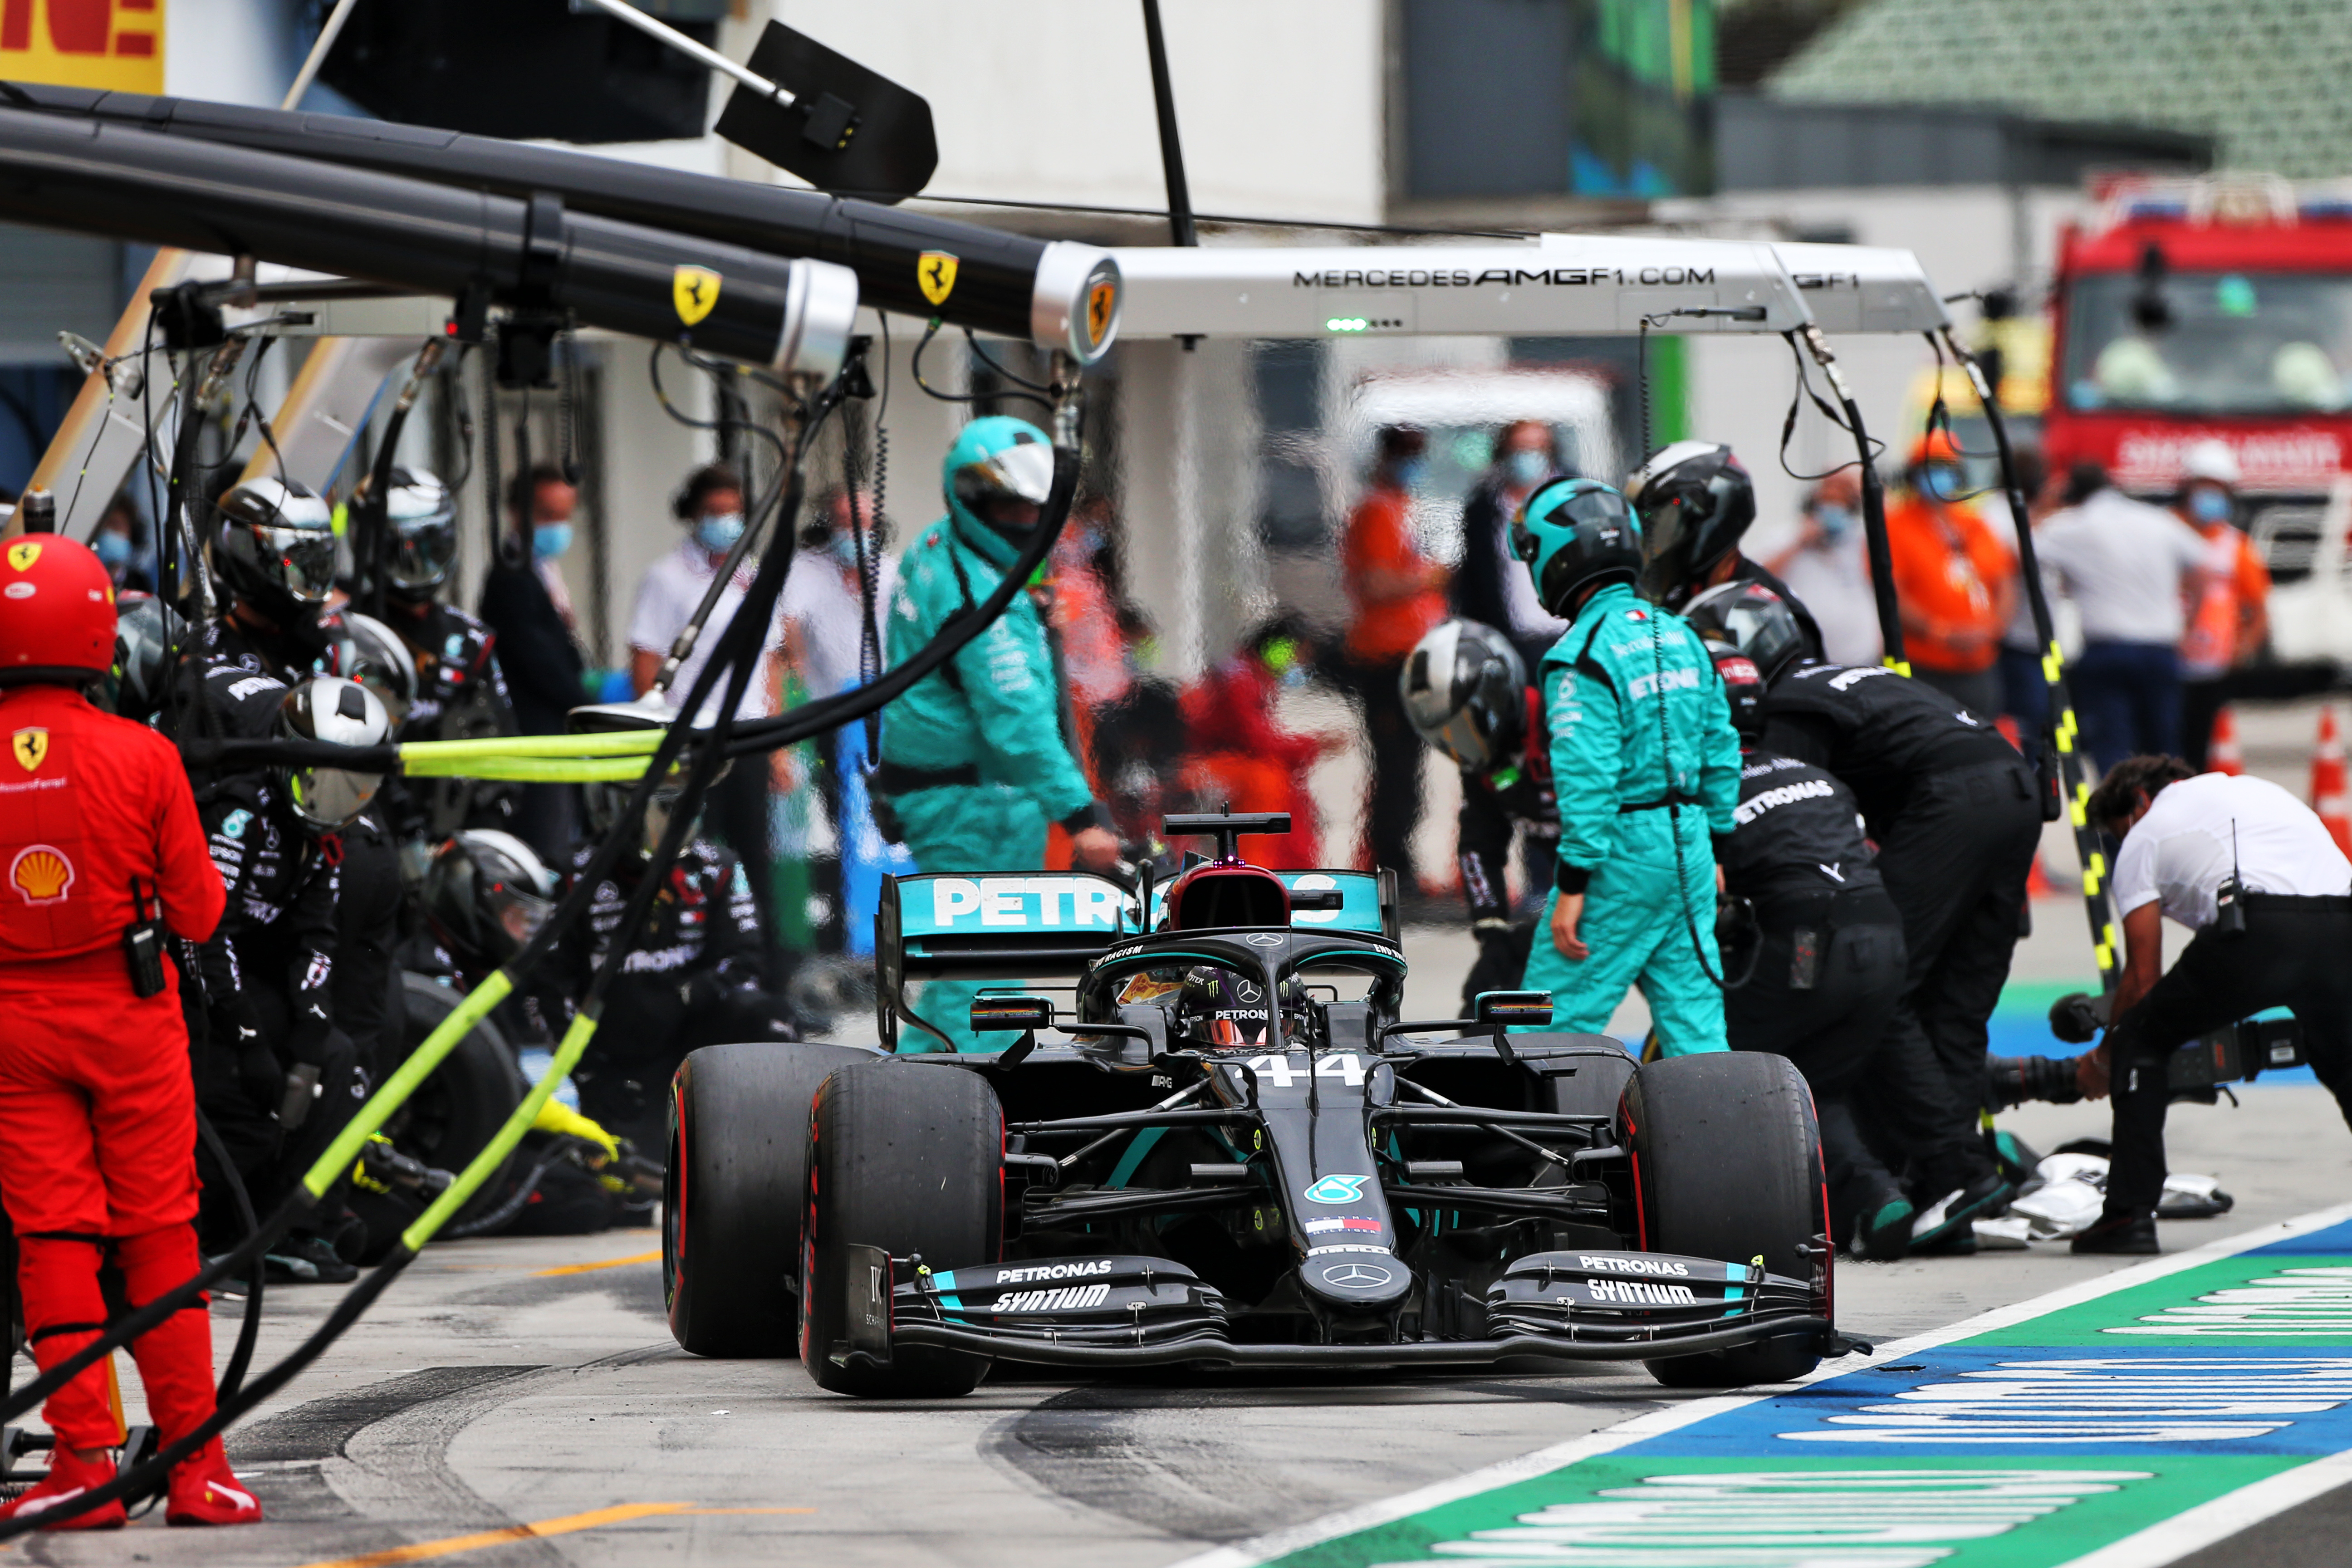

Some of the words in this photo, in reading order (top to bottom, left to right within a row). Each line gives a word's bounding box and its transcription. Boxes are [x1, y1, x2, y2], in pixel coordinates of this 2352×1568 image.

[1293, 267, 1715, 287] MERCEDESAMGF1.COM
[1731, 779, 1834, 826] ETRONAS
[1105, 945, 1144, 962] RACISM
[1372, 943, 1392, 956] END
[1215, 1009, 1284, 1020] PETRONS
[1159, 1076, 1172, 1088] AMG
[1234, 1054, 1378, 1088] 44
[995, 1260, 1112, 1285] PETRONAS
[1578, 1255, 1689, 1277] PETRONAS
[990, 1284, 1111, 1313] SYNTIUM
[1588, 1279, 1697, 1305] SYNTIUM
